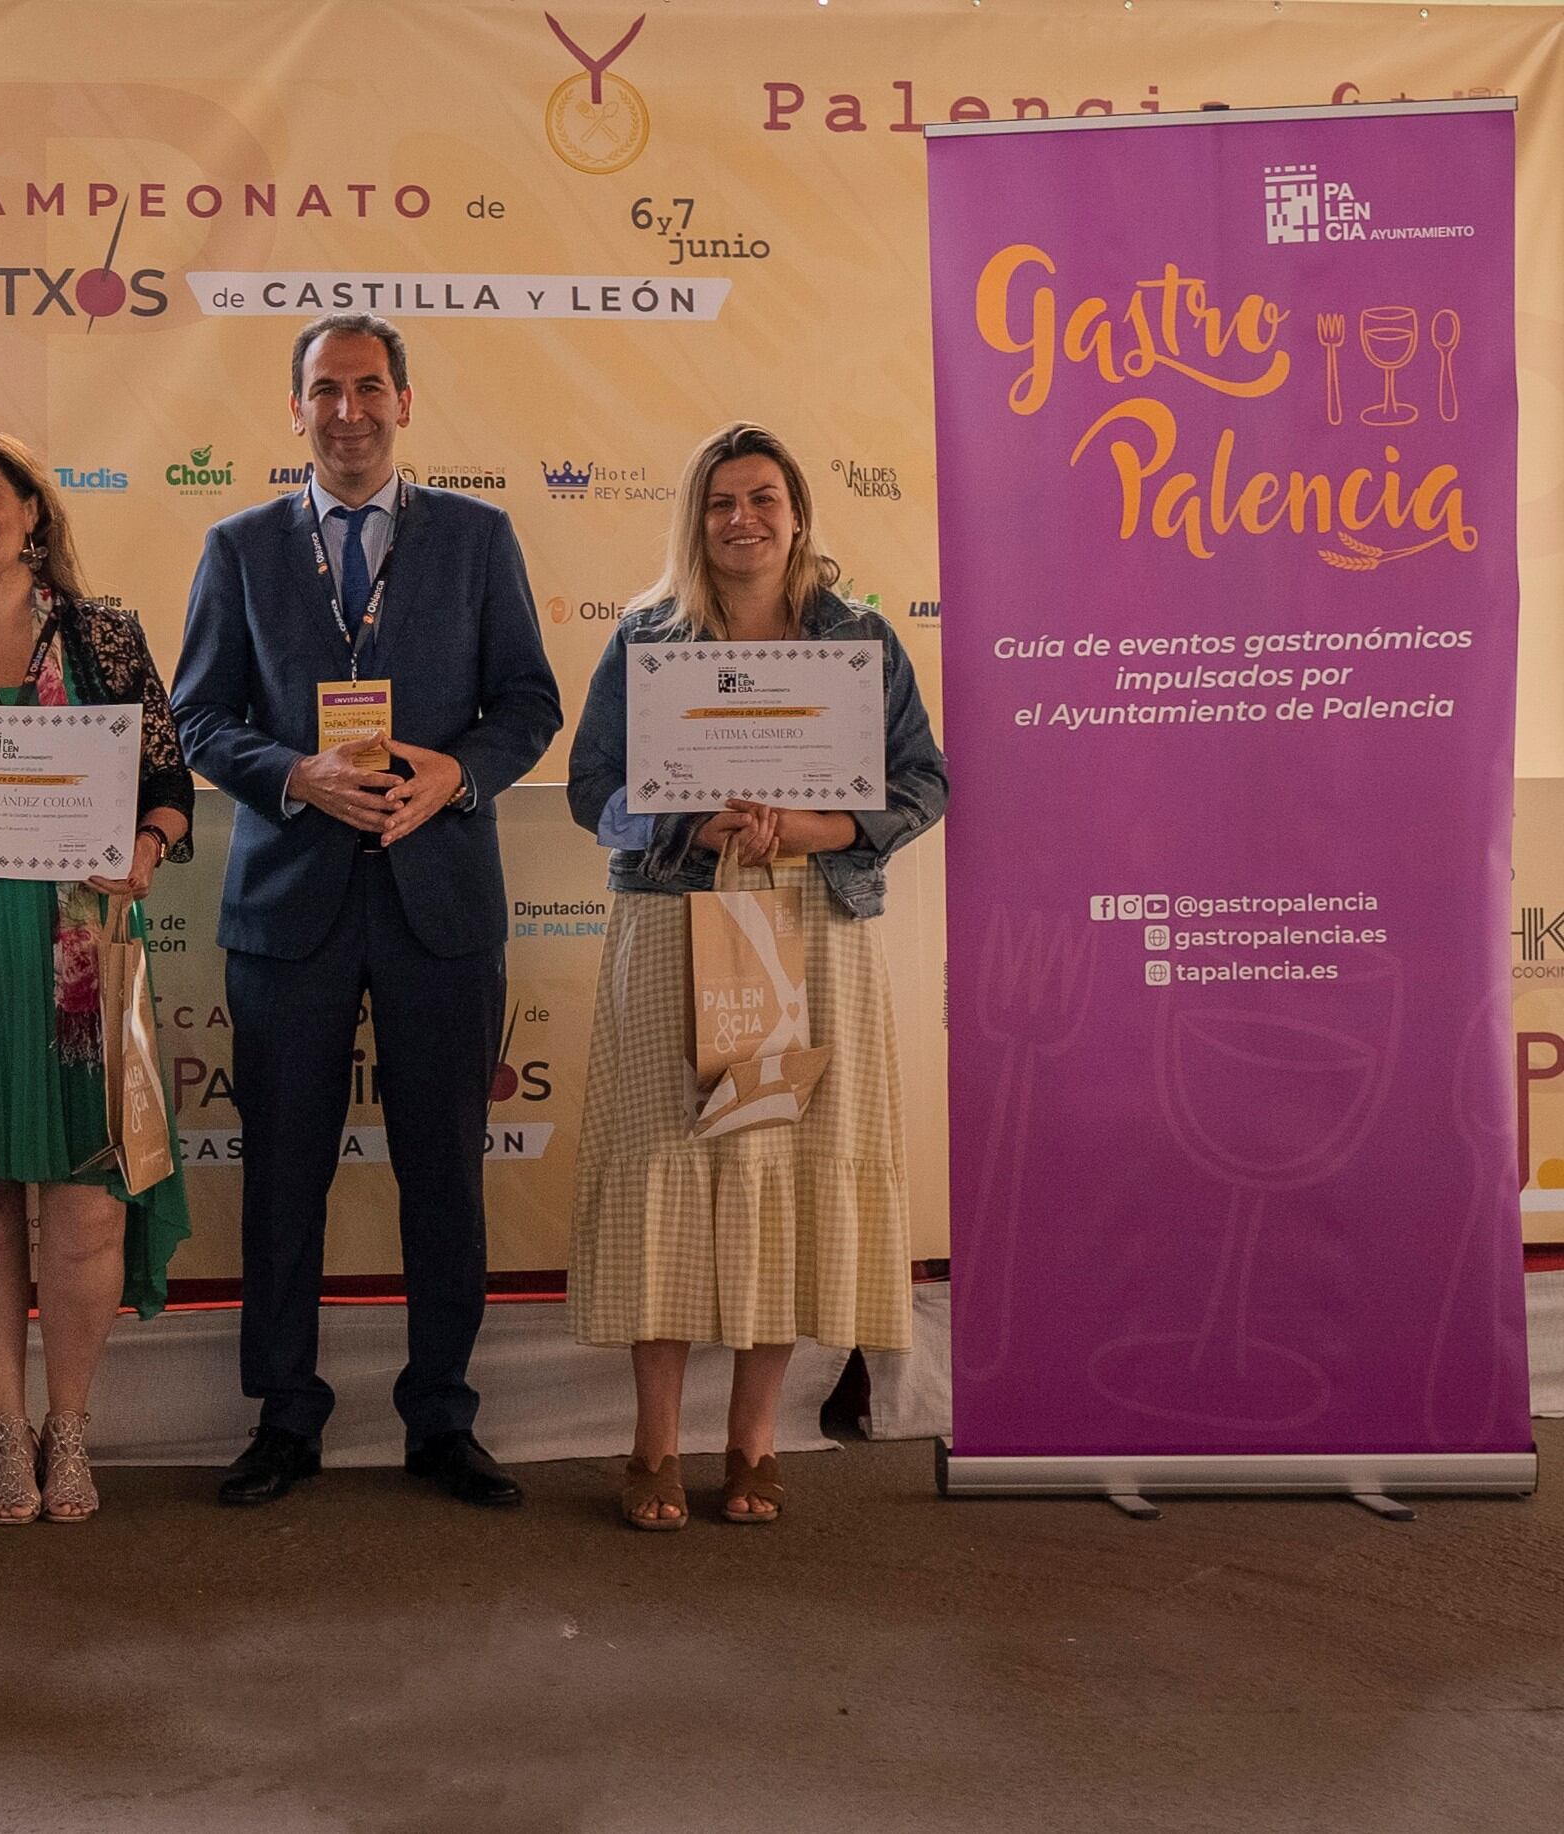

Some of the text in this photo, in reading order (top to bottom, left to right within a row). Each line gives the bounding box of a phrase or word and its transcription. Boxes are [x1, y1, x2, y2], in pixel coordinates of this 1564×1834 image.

[1323, 184, 1354, 201] PA
[466, 195, 505, 219] de
[1324, 203, 1371, 220] LEN
[1324, 222, 1474, 241] CIA AYUNTAMIENTO
[667, 231, 771, 265] junio
[212, 280, 696, 313] de CASTILLA Y LEÓN
[974, 244, 1292, 415] Gastro
[54, 467, 128, 489] Tudis
[165, 460, 234, 486] Choví
[595, 467, 646, 481] Hotel
[1070, 398, 1478, 559] Palencia
[595, 487, 620, 500] REY
[854, 482, 901, 501] NEROS
[366, 580, 385, 614] Oblanca
[580, 603, 625, 620] Obla
[993, 625, 1473, 660] Guía de eventos gastronómicos
[1114, 663, 1353, 692] impulsados por
[334, 696, 374, 704] INVITADOS
[1014, 692, 1454, 730] el Ayuntamiento de Palencia
[704, 727, 804, 741] FÁTIMA GISMERO
[43, 796, 94, 808] COLOMA
[514, 901, 606, 921] Diputación
[1174, 892, 1379, 919] @gastropalencia
[160, 914, 187, 931] de
[515, 922, 539, 937] DE
[147, 936, 187, 953] eón
[1175, 926, 1388, 951] gastropalencia.es
[1176, 960, 1339, 985] tapalencia.es
[702, 987, 765, 1013] PALEN
[524, 1006, 550, 1023] de
